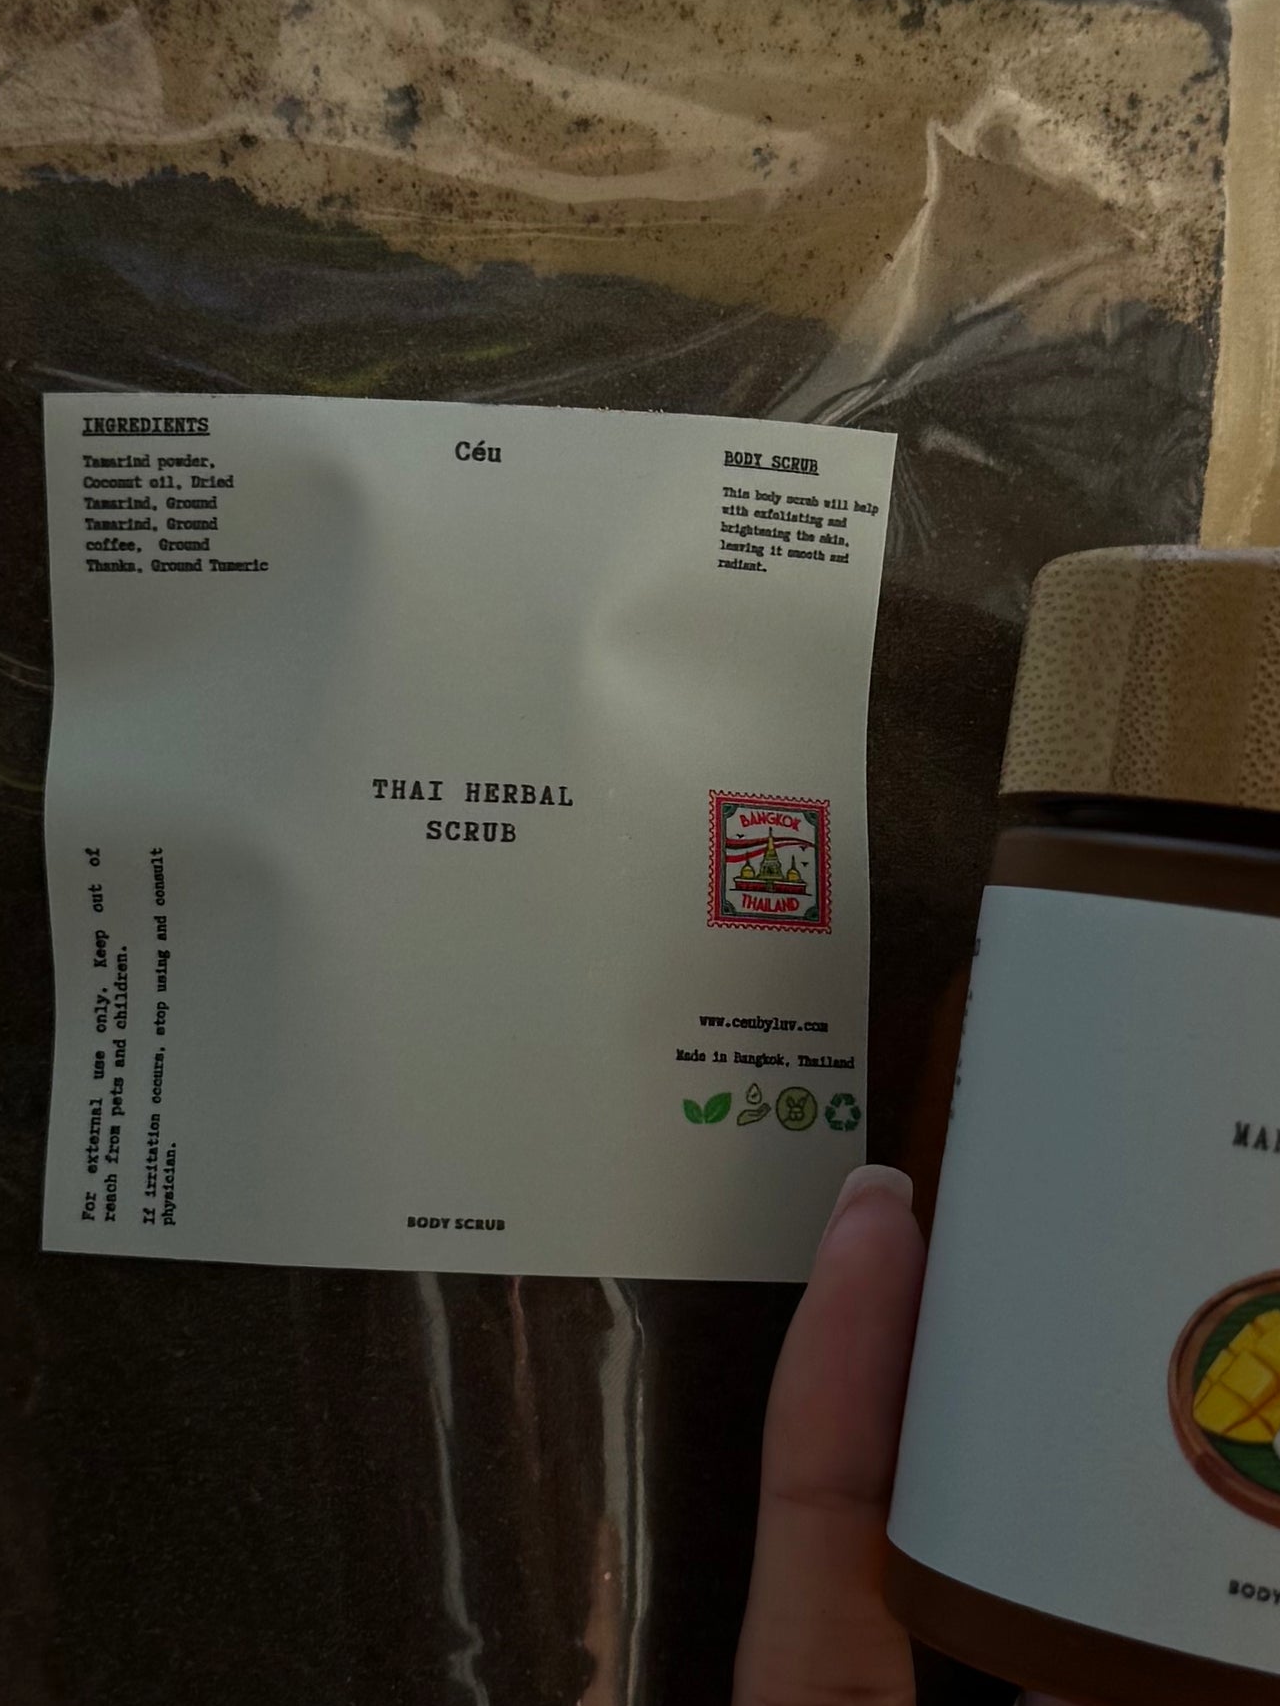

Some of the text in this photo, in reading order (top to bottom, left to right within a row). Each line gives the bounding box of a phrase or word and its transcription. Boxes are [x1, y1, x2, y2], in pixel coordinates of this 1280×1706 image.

[82, 418, 210, 436] INGREDIENTS
[83, 454, 150, 468] Tamarind
[455, 440, 501, 462] Céu
[724, 451, 819, 476] BODY SCRUB
[83, 476, 142, 488] Coconut
[191, 475, 234, 488] Dried
[166, 496, 217, 509] Ground
[723, 487, 879, 516] This body scrub will help
[167, 517, 218, 530] Ground
[722, 505, 748, 516] with
[827, 517, 847, 528] and
[721, 521, 791, 542] brightening
[797, 530, 815, 542] the
[159, 538, 210, 551] Ground
[720, 540, 849, 563] leaving it smooth and
[151, 559, 202, 572] Ground
[373, 779, 573, 806] THAI HERBAL
[426, 821, 516, 842] SCRUB
[739, 812, 802, 831] BANGKOK
[86, 848, 100, 866] of
[153, 848, 165, 906] consult
[92, 885, 103, 912] out
[742, 894, 799, 913] THAILAND
[155, 916, 167, 941] and
[94, 930, 109, 967] Keep
[156, 950, 170, 992] using
[155, 1002, 169, 1035] stop
[114, 1039, 126, 1067] and
[676, 1049, 706, 1061] Made
[712, 1051, 727, 1063] in
[798, 1055, 855, 1069] Thailand
[94, 1051, 105, 1079] use
[110, 1077, 124, 1116] pets
[86, 1099, 102, 1173] external
[105, 1126, 120, 1163] from
[145, 1114, 160, 1197] irritation
[82, 1192, 96, 1221] For
[104, 1174, 117, 1221] reach
[143, 1208, 155, 1224] If
[408, 1217, 505, 1230] BODY SCRUB
